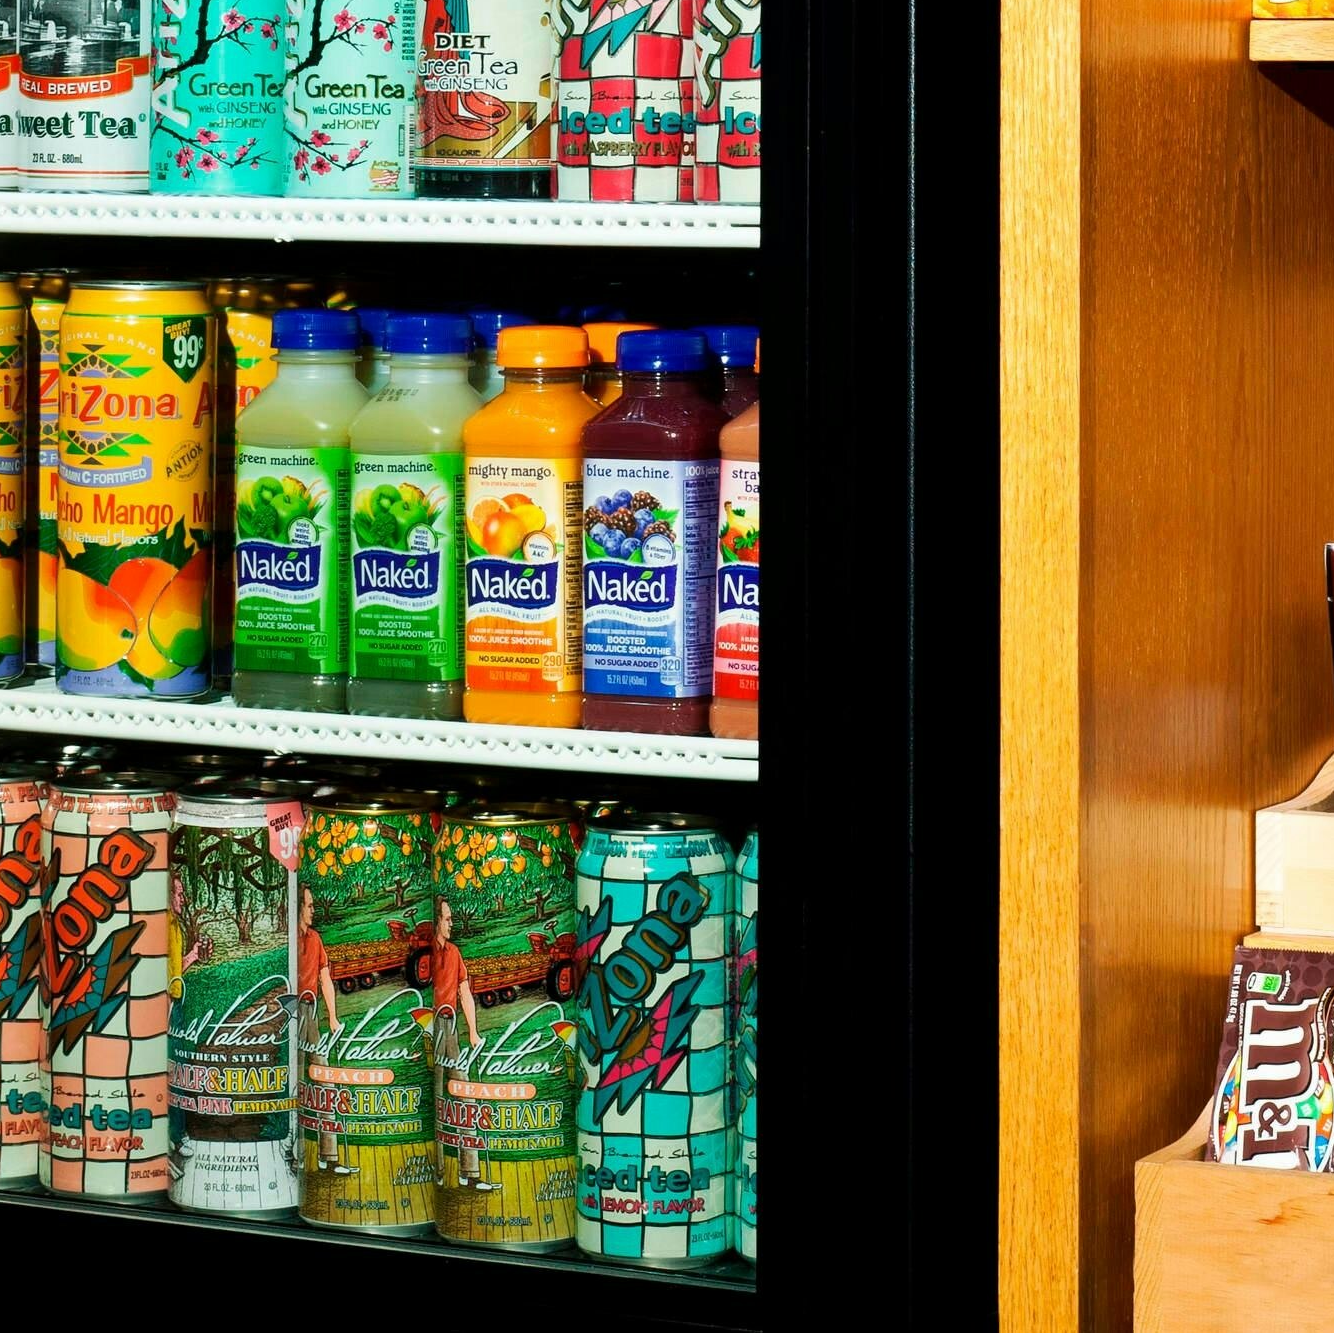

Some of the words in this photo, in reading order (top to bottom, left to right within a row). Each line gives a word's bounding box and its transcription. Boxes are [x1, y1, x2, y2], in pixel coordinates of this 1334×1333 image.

[435, 34, 491, 50] DIET
[472, 51, 518, 75] Tea
[47, 80, 112, 94] BREWED
[189, 73, 254, 97] Green
[305, 74, 366, 99] Green
[367, 74, 405, 98] Tea
[438, 77, 508, 91] GINSENG
[217, 102, 277, 114] GINSENG
[329, 103, 391, 115] GINSENG
[79, 111, 137, 138] Tea
[225, 118, 266, 129] HONEY
[337, 120, 380, 130] HONEY
[107, 334, 156, 355] BRAND
[173, 335, 204, 369] 99¢
[468, 465, 507, 479] mighty
[510, 465, 555, 480] mango.
[586, 465, 612, 477] blue
[617, 467, 674, 479] machine.
[93, 494, 174, 534] Mango
[241, 550, 314, 582] Naked.
[361, 557, 432, 589] Naked.
[471, 567, 550, 601] Naked.
[587, 570, 669, 603] Naked.
[231, 1052, 270, 1062] STYLE
[313, 1068, 385, 1083] PEACH
[451, 1082, 528, 1097] PEACH
[197, 1099, 231, 1114] PINK
[91, 1104, 152, 1129] tea
[650, 1165, 710, 1191] tea
